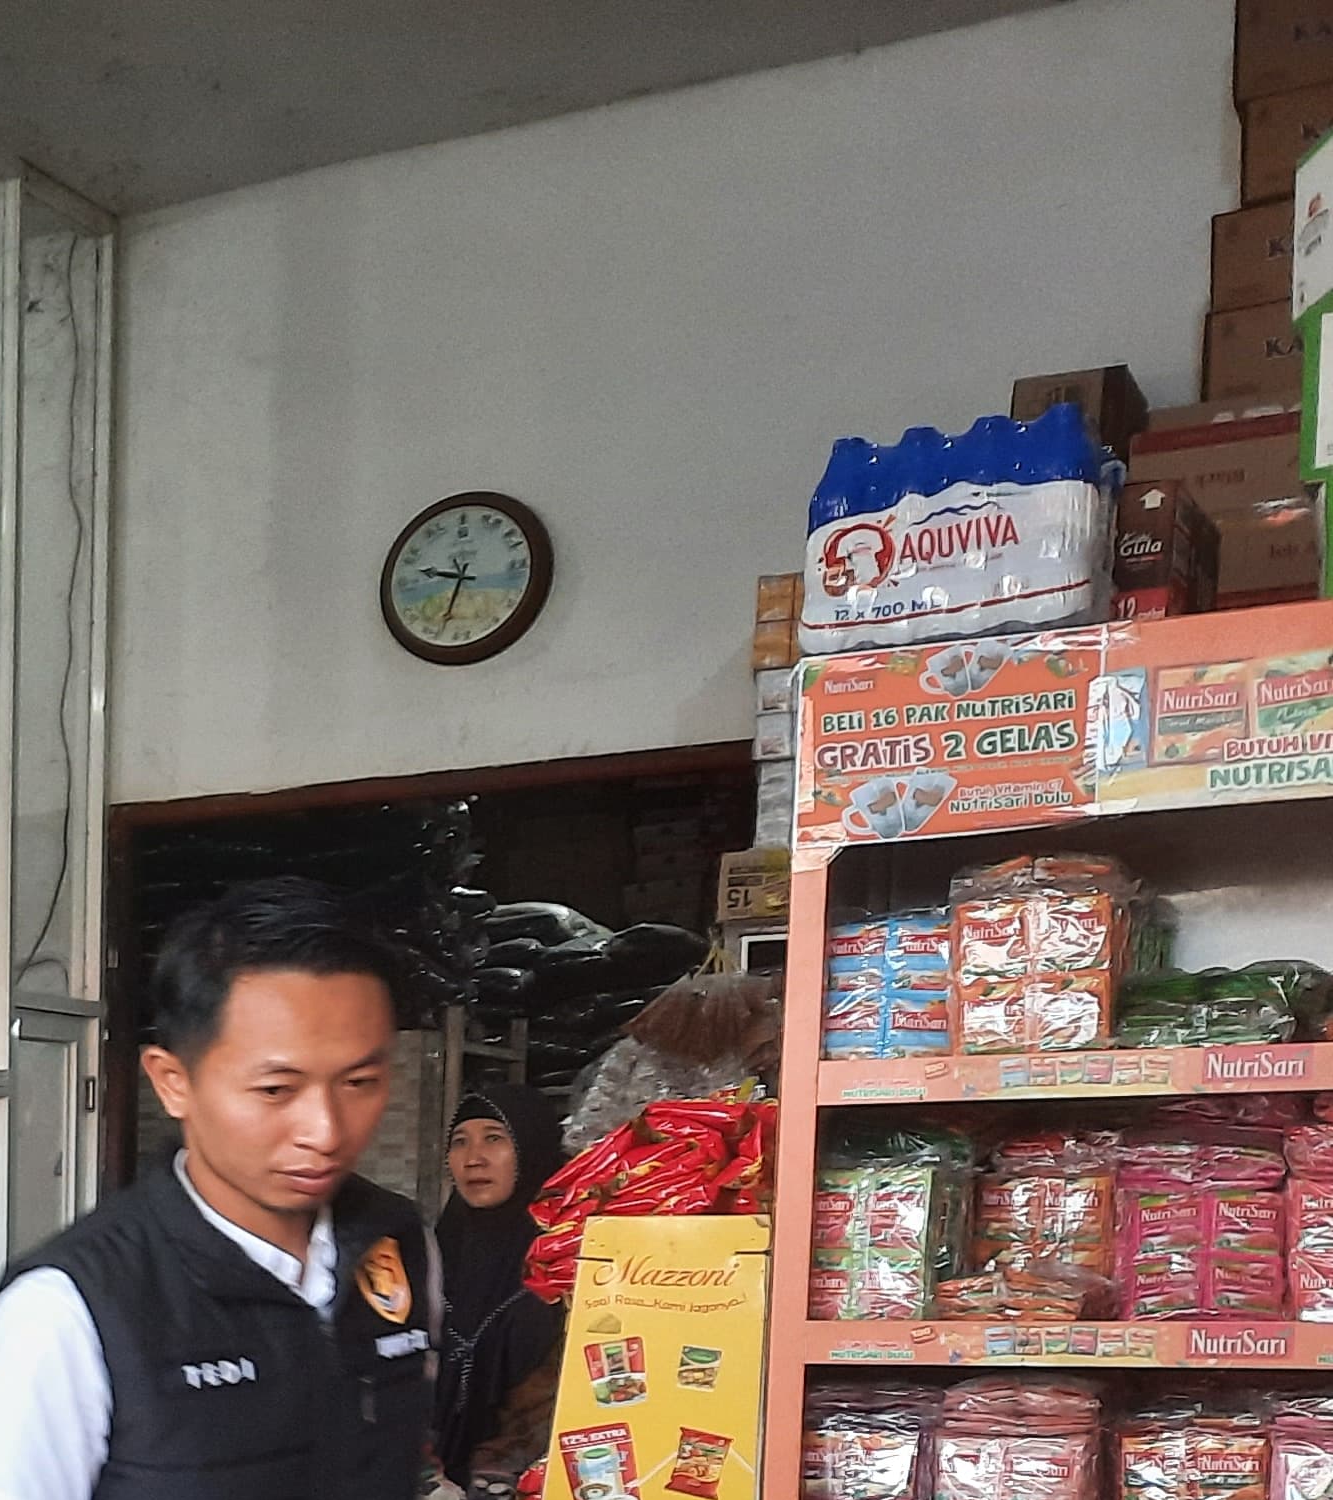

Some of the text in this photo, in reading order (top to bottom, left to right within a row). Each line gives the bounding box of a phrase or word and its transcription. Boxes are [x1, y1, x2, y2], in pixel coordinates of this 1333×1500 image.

[899, 515, 1020, 564] AQUVIVA
[1120, 539, 1163, 556] Gula
[835, 604, 851, 620] 12
[872, 601, 905, 619] 700
[822, 691, 1076, 734] BELI 16 PAK NUTRISARI
[1162, 689, 1238, 711] NutriSari
[816, 736, 933, 770] GRATIS
[943, 731, 966, 759] 2
[975, 720, 1077, 756] GELAS
[1225, 731, 1333, 759] BUTUH VI
[1033, 791, 1073, 807] Dulu
[1205, 1053, 1306, 1080] NutriSari
[1219, 1203, 1277, 1221] NutriSari
[593, 1255, 741, 1287] Mazzoni
[1190, 1329, 1287, 1358] NutriSari
